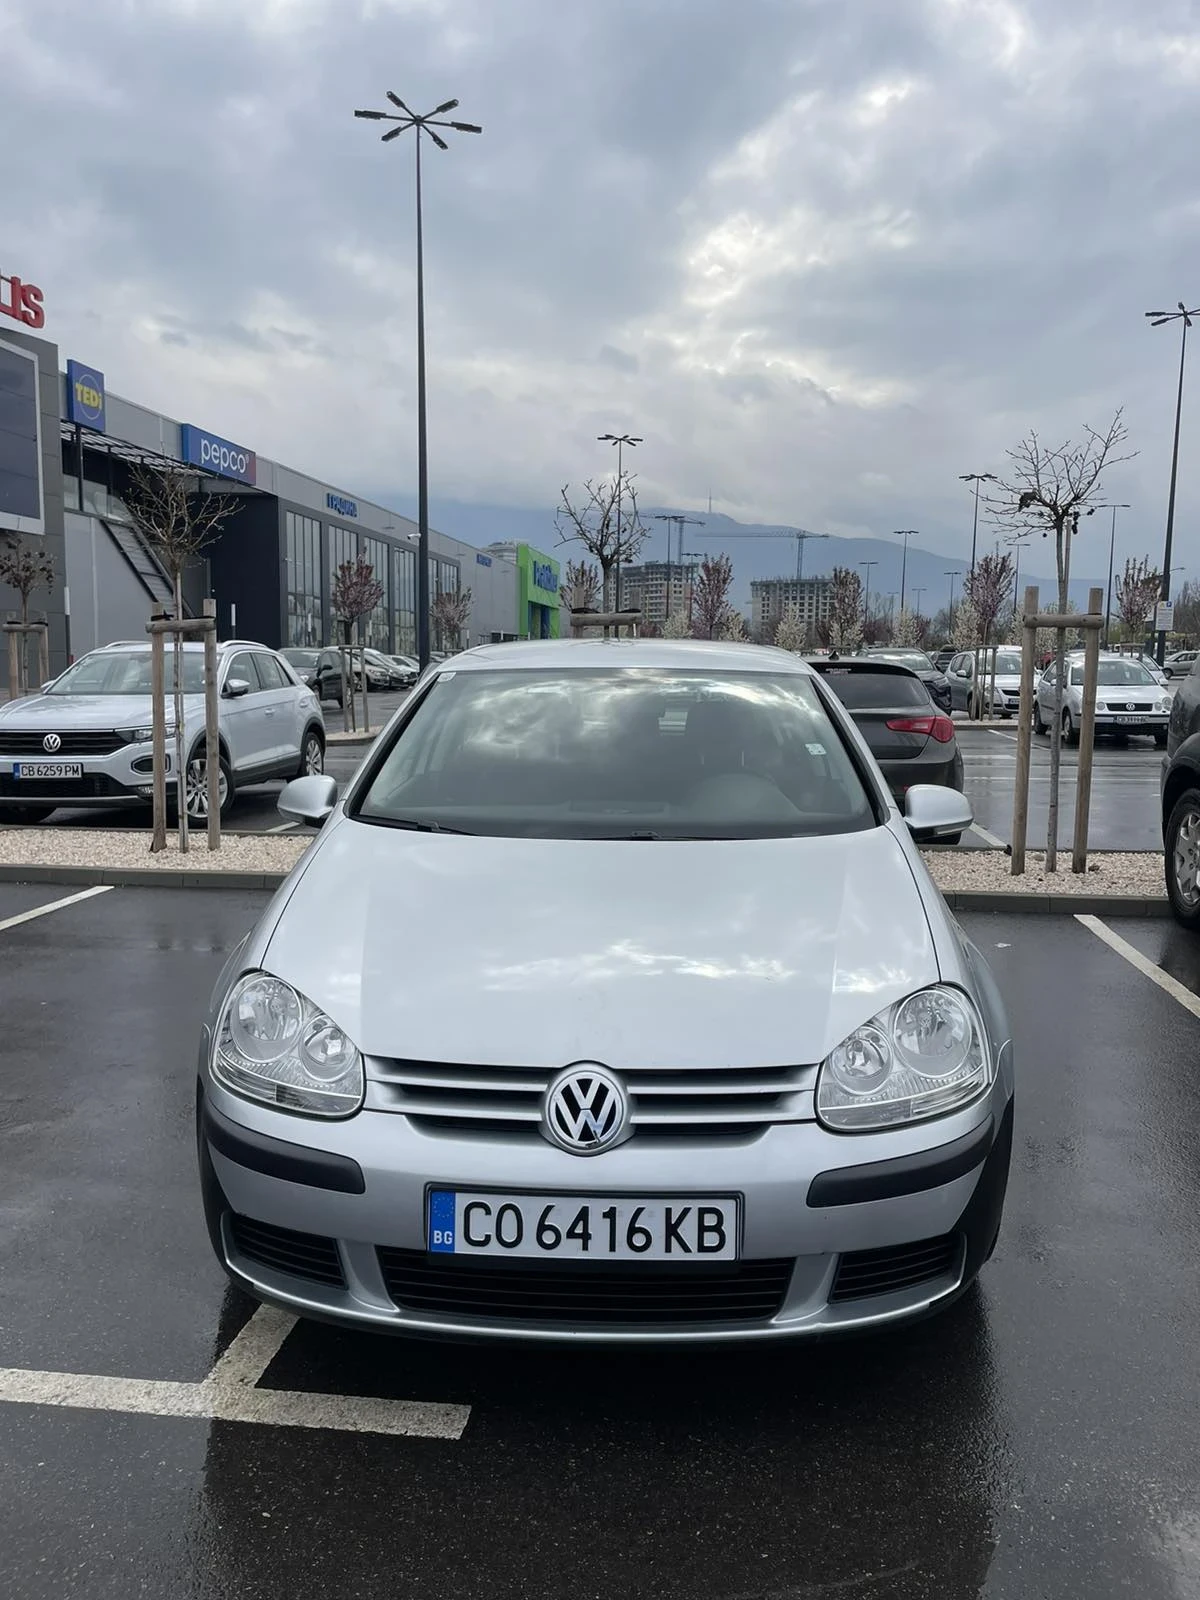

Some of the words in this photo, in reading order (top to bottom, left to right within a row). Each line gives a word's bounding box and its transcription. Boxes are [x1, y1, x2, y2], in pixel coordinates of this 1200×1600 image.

[21, 765, 35, 777] CB
[37, 765, 63, 777] 6259
[64, 765, 80, 777] PM
[463, 1201, 523, 1249] CO
[535, 1204, 653, 1253] 6416
[664, 1206, 726, 1254] KB
[433, 1230, 453, 1245] BG
